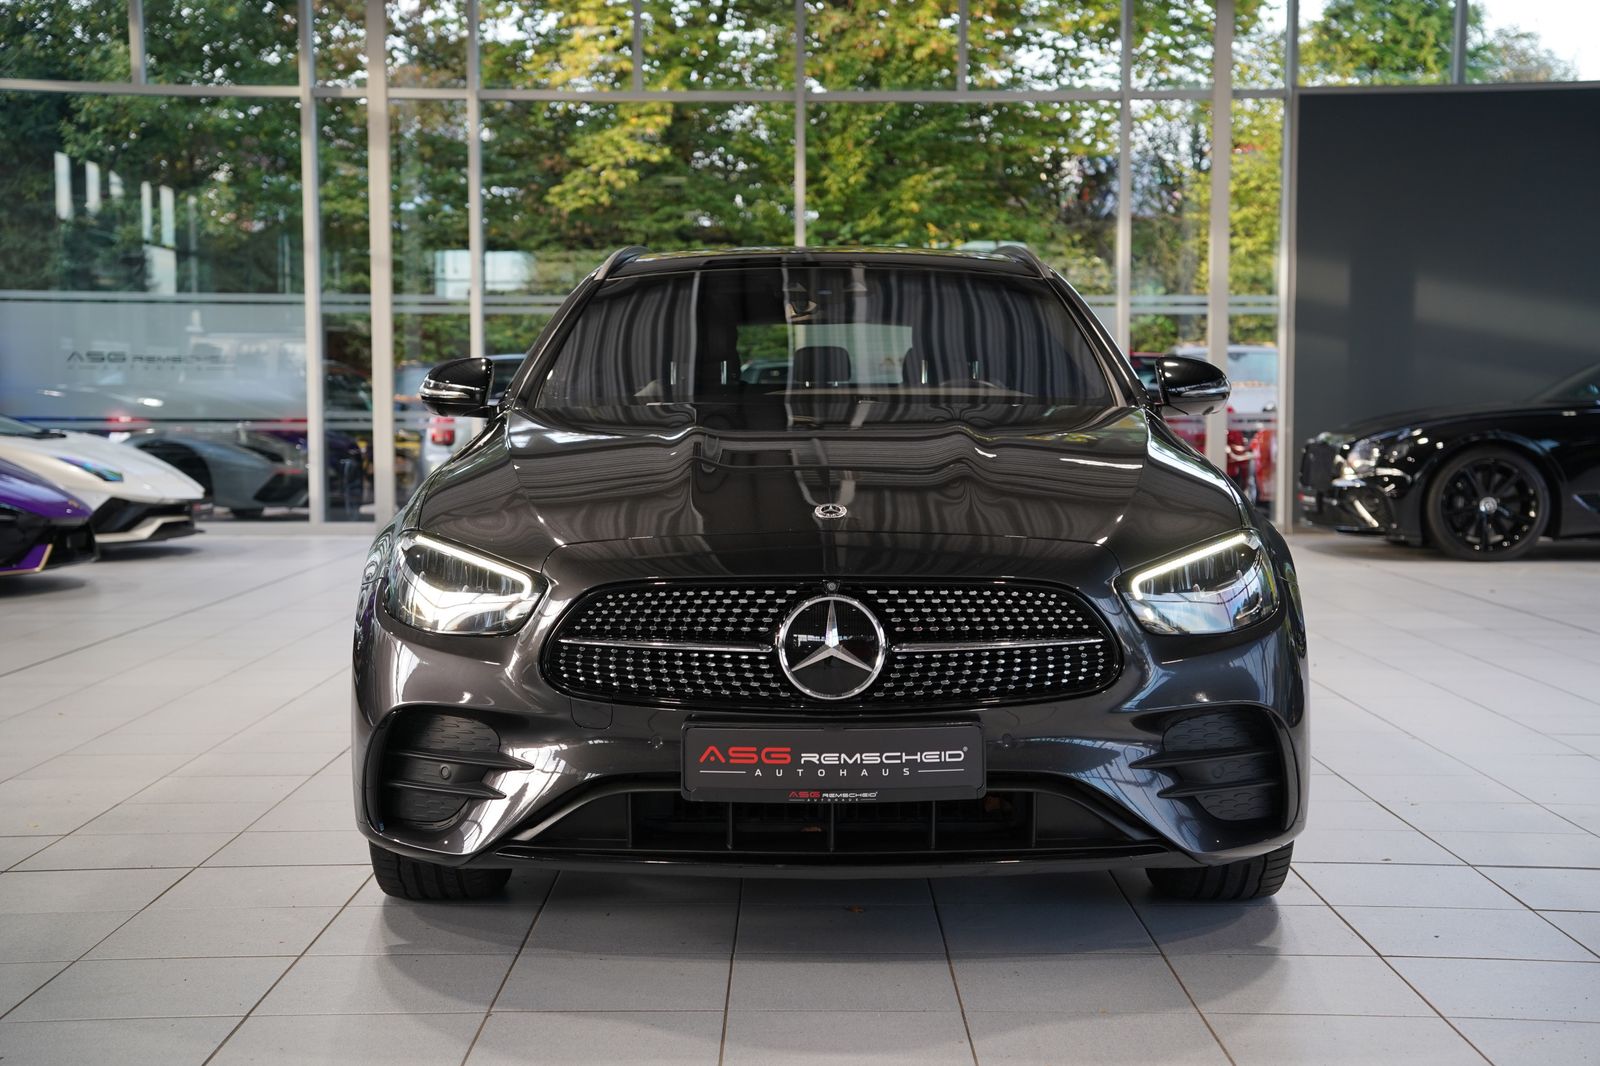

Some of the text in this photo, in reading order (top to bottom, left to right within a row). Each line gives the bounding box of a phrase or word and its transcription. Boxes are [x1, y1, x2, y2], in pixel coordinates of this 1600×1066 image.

[67, 351, 126, 363] ASG
[700, 746, 965, 765] ASG REMSCHEID
[755, 768, 911, 777] AUTOHAUS
